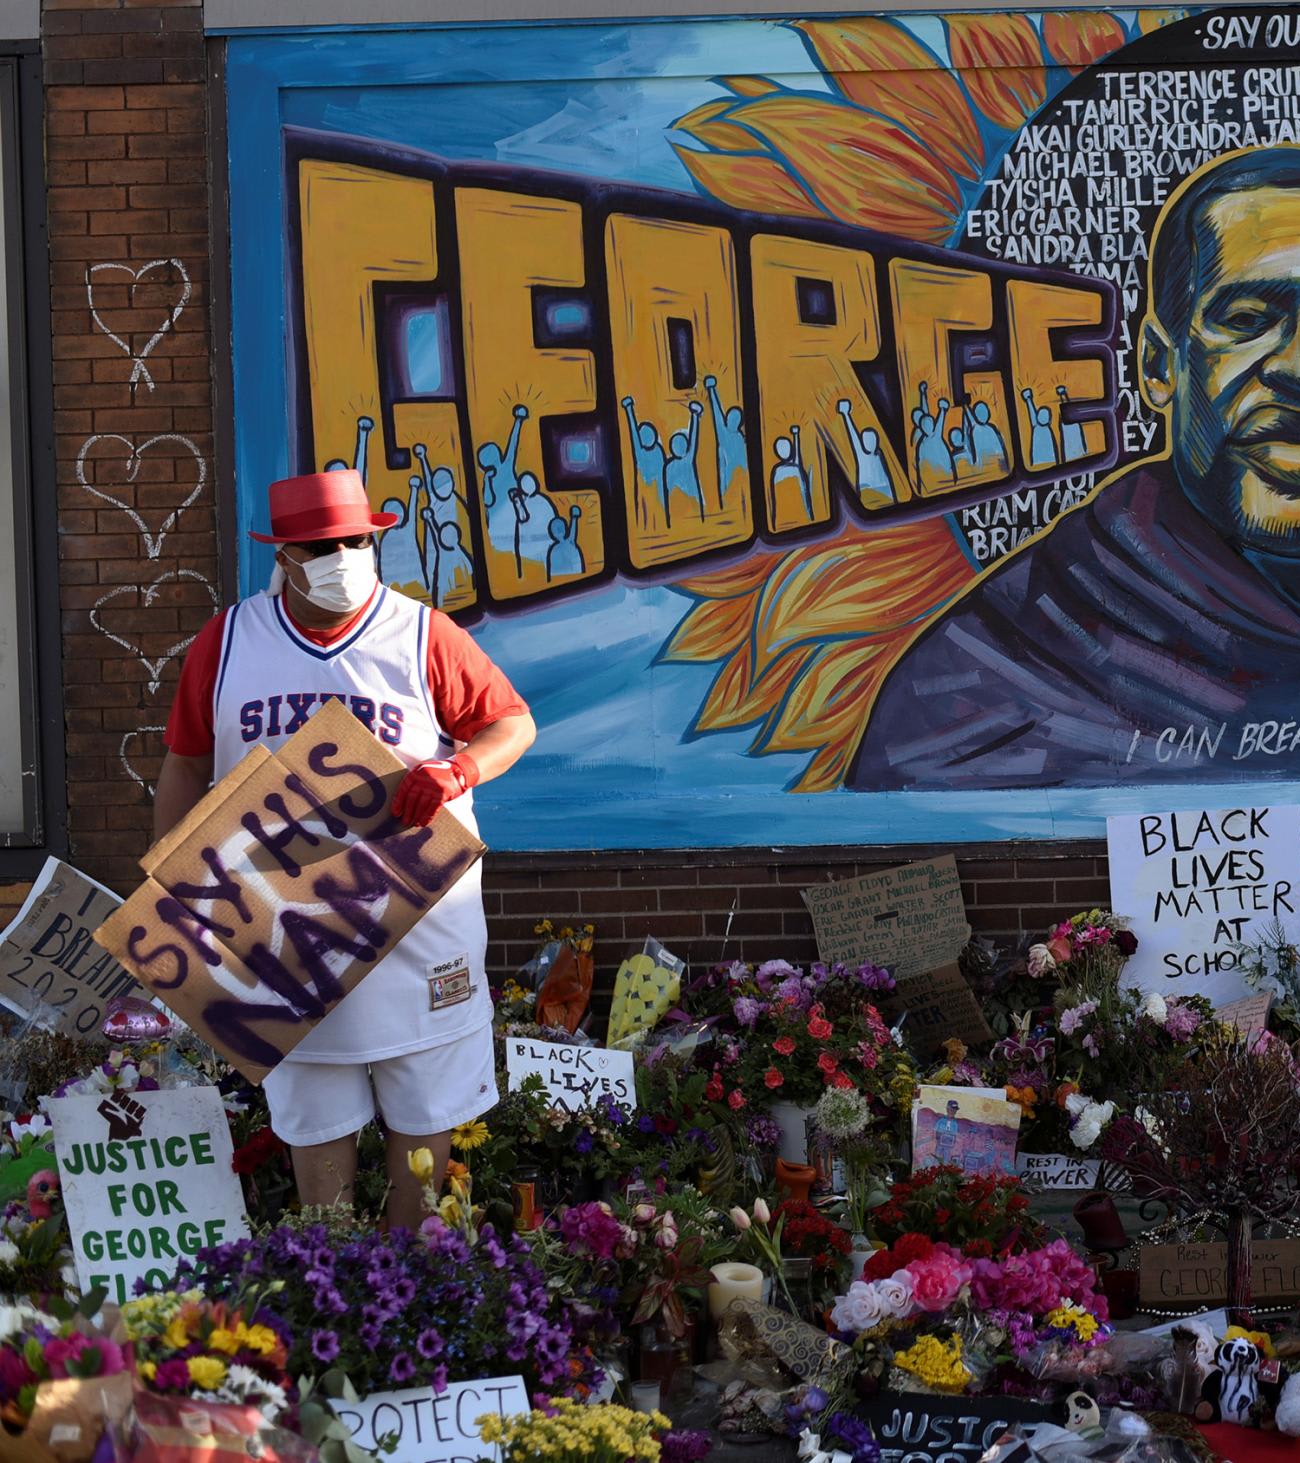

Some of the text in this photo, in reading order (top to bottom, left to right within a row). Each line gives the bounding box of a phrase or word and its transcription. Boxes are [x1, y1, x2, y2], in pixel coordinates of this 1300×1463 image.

[1203, 15, 1261, 49] SAY
[1096, 69, 1238, 101] TERRENCE
[1062, 99, 1150, 126] TAMIR
[1151, 98, 1219, 125] RICE
[1015, 125, 1071, 154] AKAI
[1077, 124, 1160, 152] GURLEY
[1161, 120, 1256, 150] KENDRA
[1003, 151, 1118, 181] MICHAEL
[984, 178, 1078, 211] TYISHA
[966, 206, 1144, 238] ERIC GARNER
[985, 236, 1097, 265] SANDRA
[295, 155, 1108, 614] GEORGE
[239, 692, 405, 747] SIXRS
[1125, 729, 1142, 764] I
[1154, 721, 1228, 764] CAN
[1140, 807, 1270, 857] BLACK
[128, 741, 388, 990] SAY HIS
[1171, 849, 1265, 889] LIVES
[1154, 880, 1295, 923] MATTER
[202, 814, 471, 1068] NAME
[1213, 917, 1251, 944] AT
[432, 957, 464, 974] 1996-97
[1163, 948, 1248, 978] SCHO
[515, 1044, 595, 1073] BLACK
[549, 1068, 628, 1098] LIVES
[62, 1131, 216, 1176] JUSTICE
[1026, 1157, 1084, 1168] REST IN
[1019, 1168, 1089, 1186] POWER
[107, 1179, 188, 1217] FOR
[82, 1219, 226, 1262] GEORGE
[1160, 1266, 1229, 1298] GEOR
[337, 1385, 519, 1453] ROTECT
